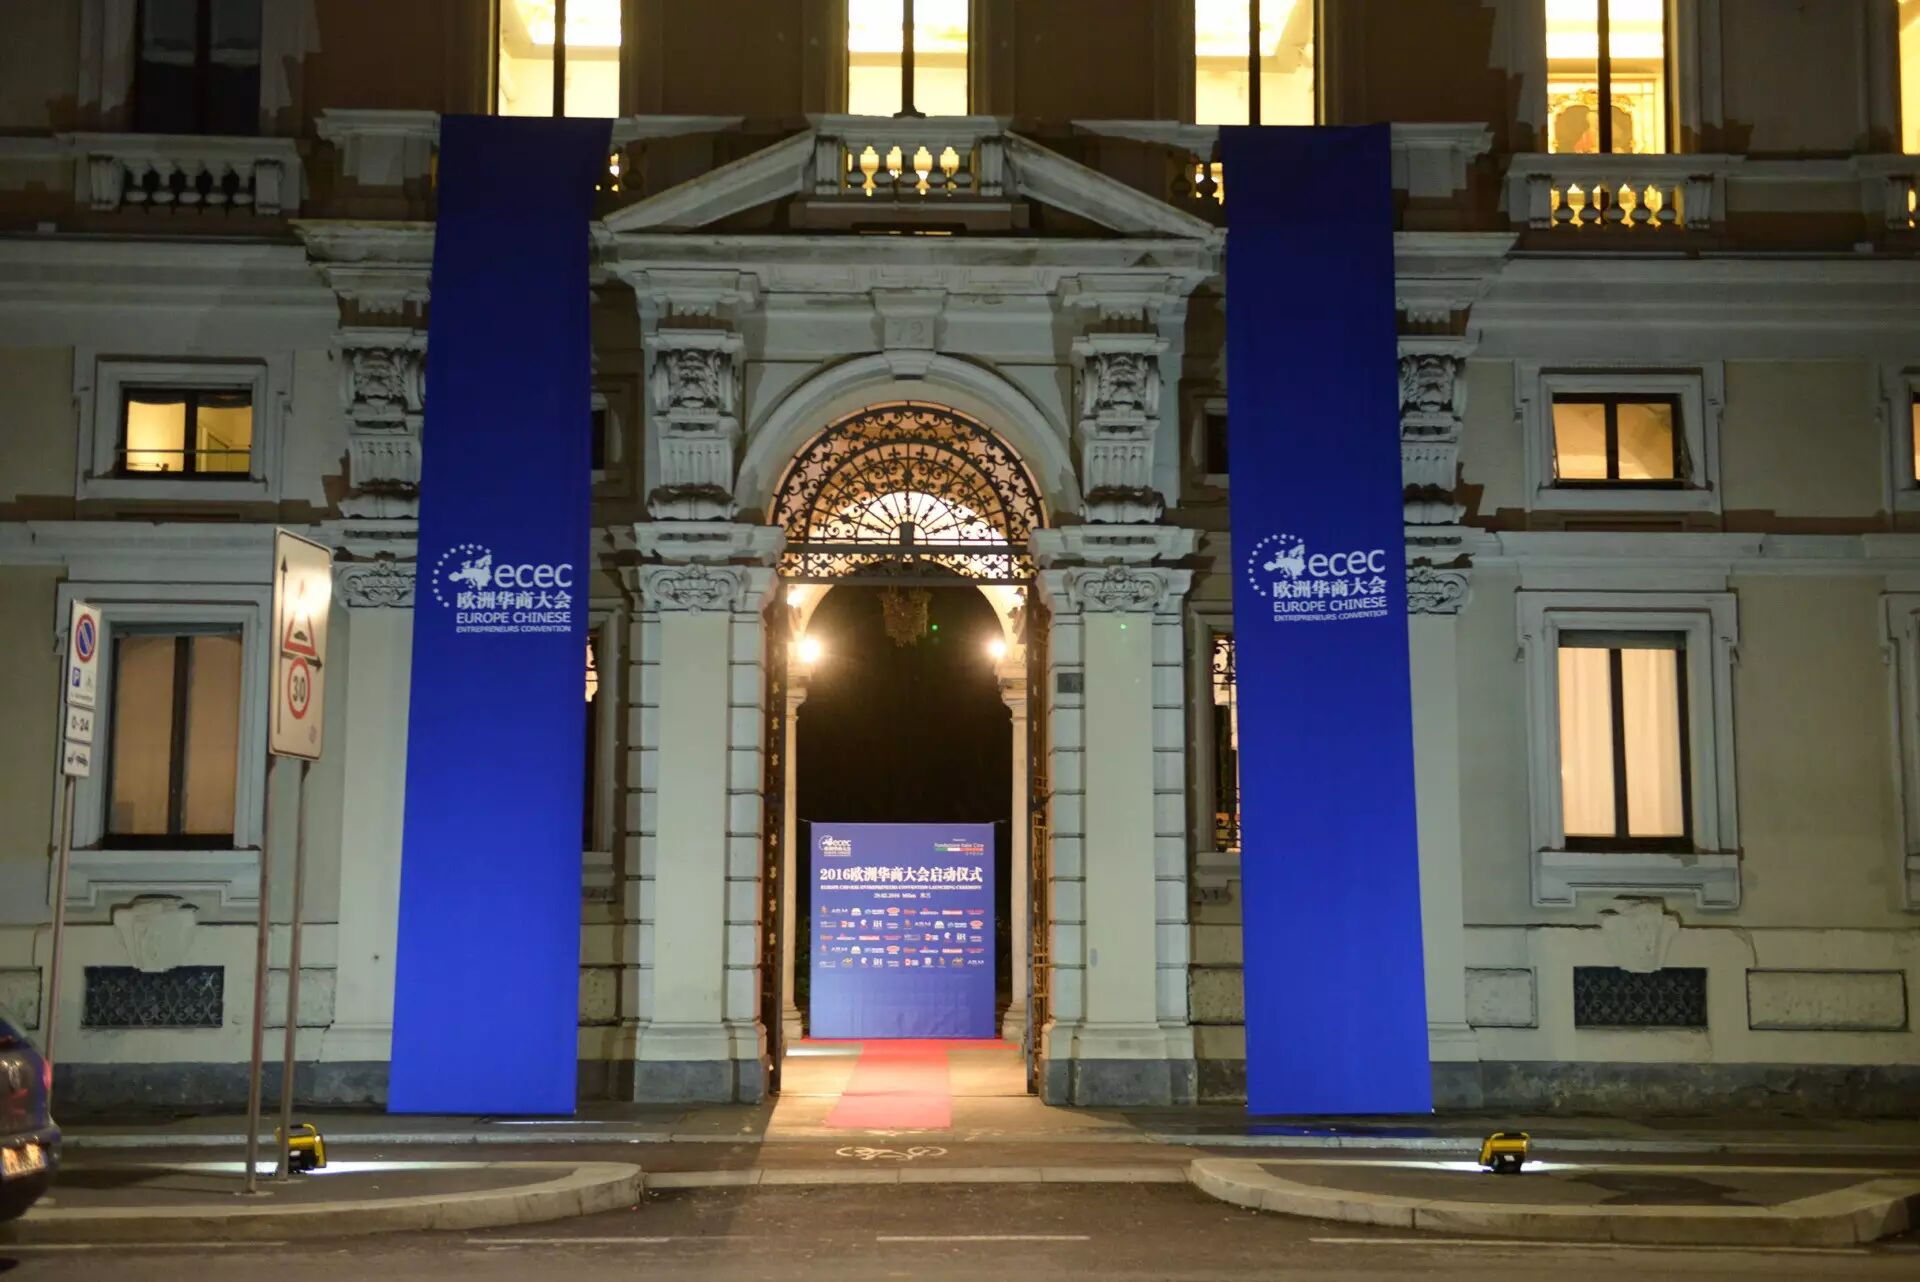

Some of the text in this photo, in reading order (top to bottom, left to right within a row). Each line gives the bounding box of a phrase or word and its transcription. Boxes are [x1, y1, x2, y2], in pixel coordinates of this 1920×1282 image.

[1308, 549, 1385, 577] ecec
[494, 563, 573, 588] ecec
[1272, 576, 1387, 598] 欧洲华商大会
[456, 590, 572, 609] 欧洲华商大会
[1273, 596, 1387, 613] EUROPE CHINESE
[456, 611, 571, 624] EUROPE CHINESE
[1274, 610, 1387, 622] ENTREPRENEURS CONVENTION
[456, 625, 519, 633] ENTREPRENEURS
[292, 675, 306, 704] 30
